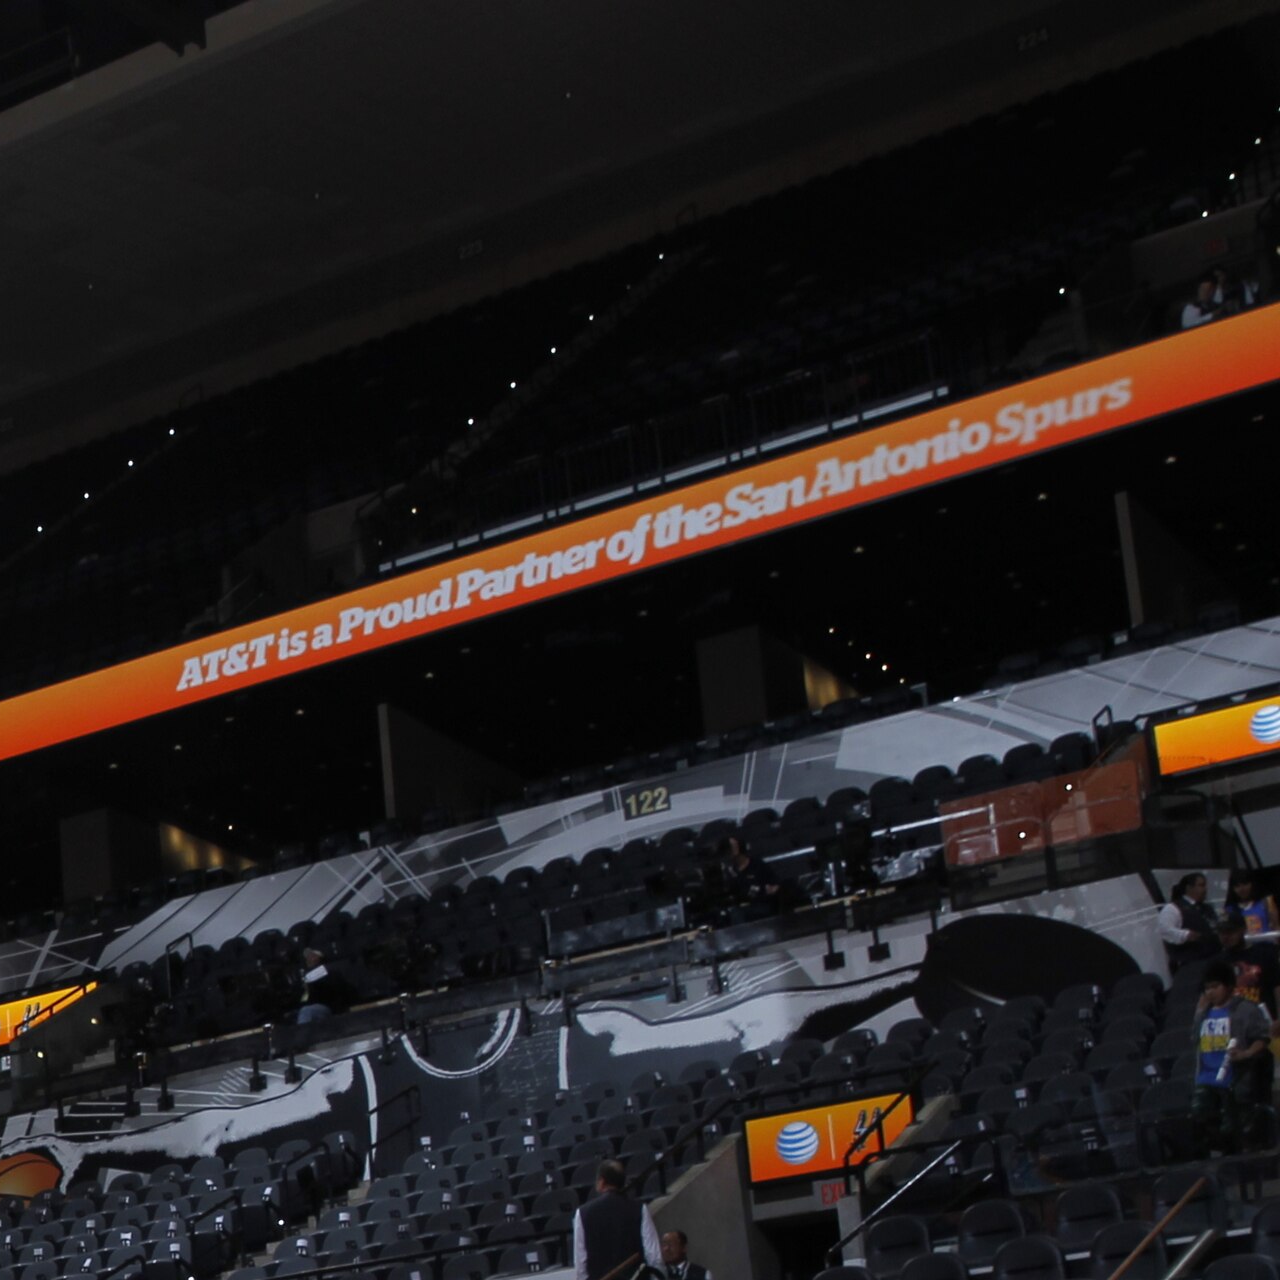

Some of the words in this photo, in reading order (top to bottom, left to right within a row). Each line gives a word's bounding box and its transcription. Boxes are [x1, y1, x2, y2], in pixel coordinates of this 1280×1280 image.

[176, 634, 275, 691] AT&T
[278, 628, 307, 660] is
[311, 624, 333, 651] a
[336, 581, 453, 643] Proud
[454, 537, 605, 608] Partner
[607, 514, 652, 564] of
[653, 504, 723, 548] the
[722, 476, 806, 528] San
[808, 418, 991, 501] Antonio
[994, 377, 1133, 444] Spurs
[626, 787, 669, 816] 122
